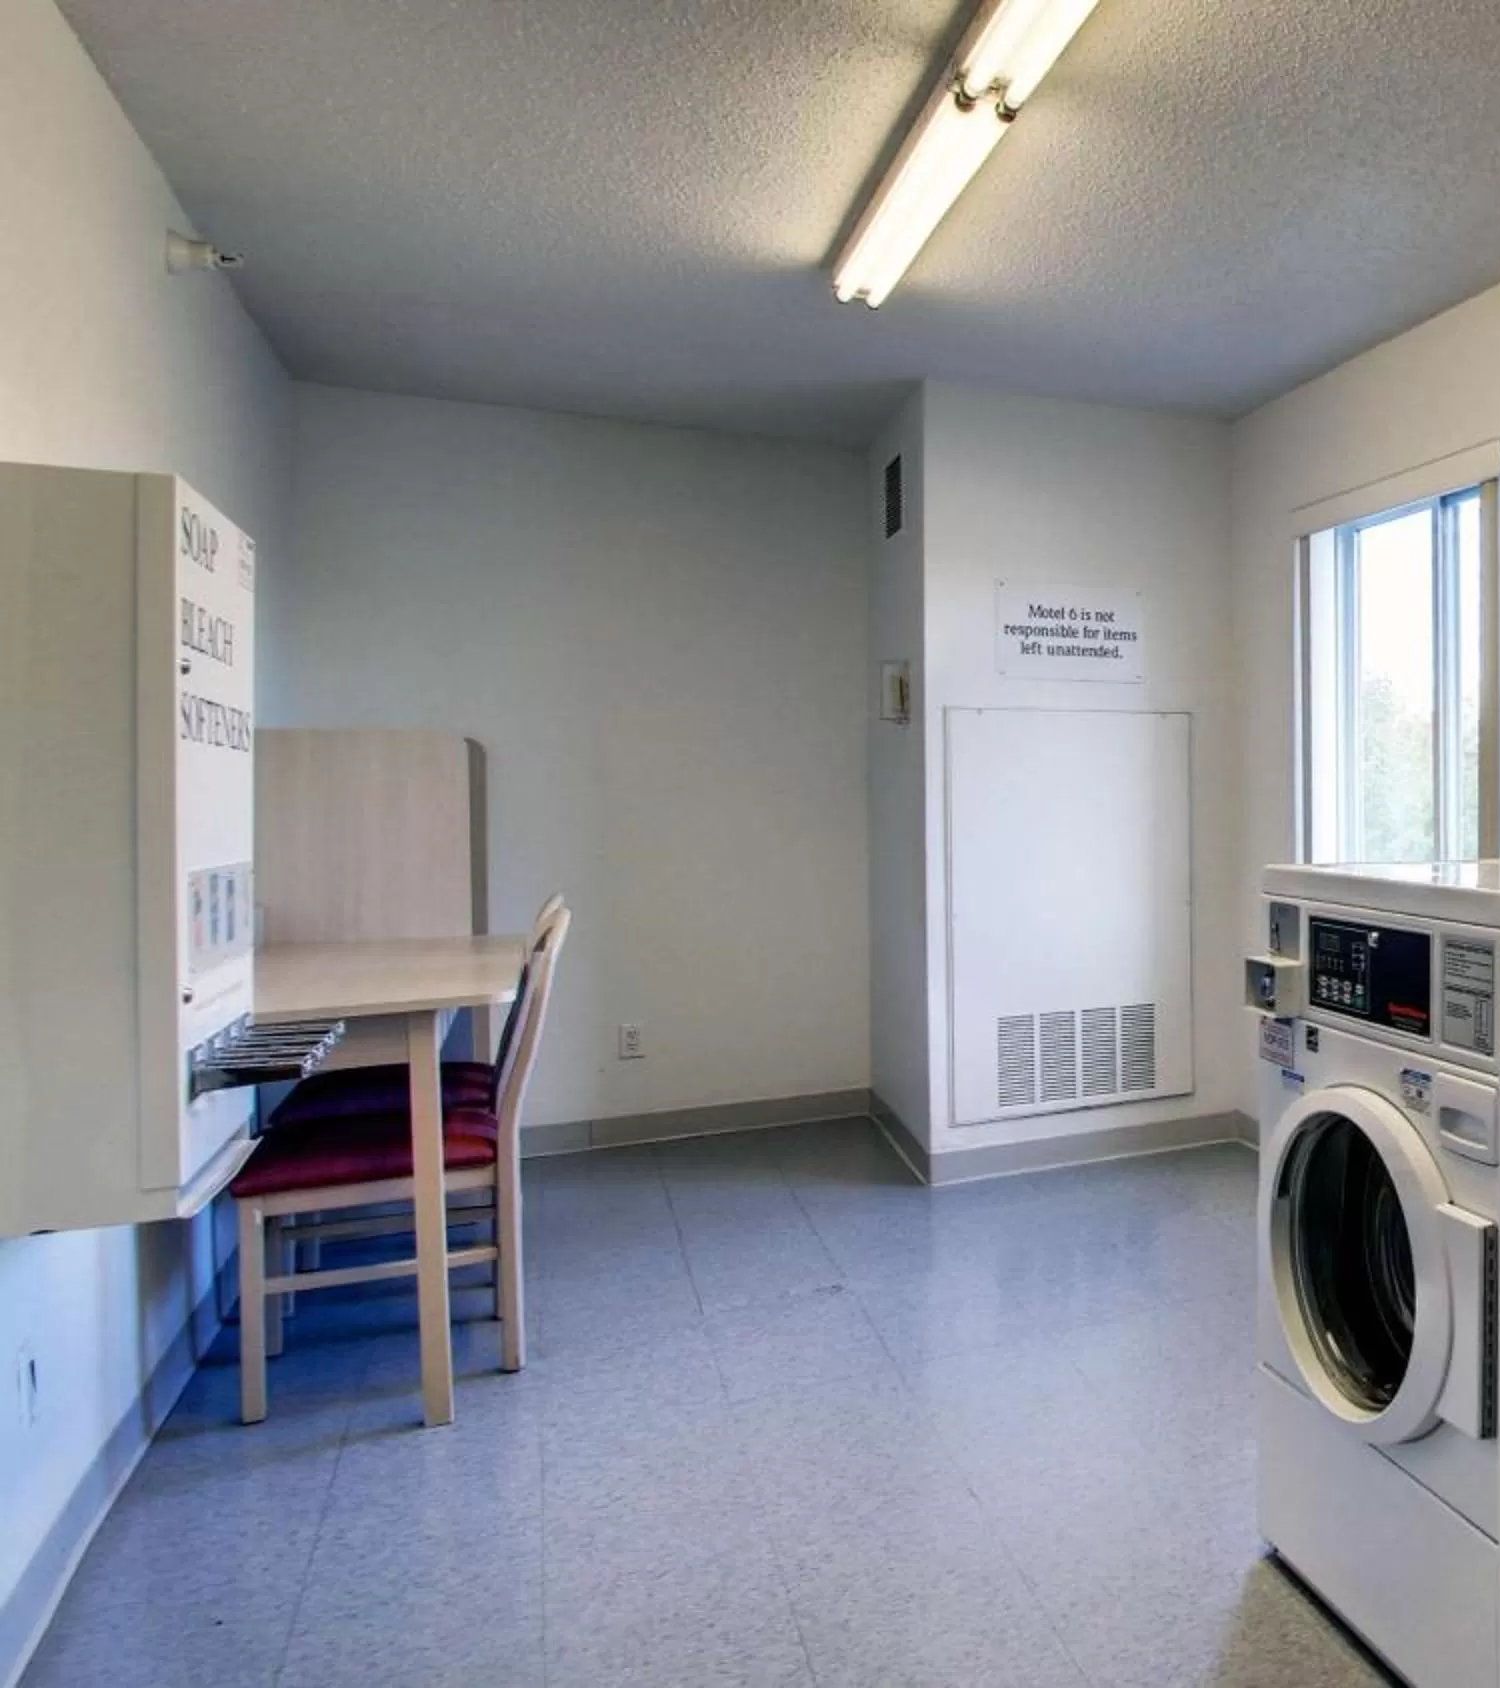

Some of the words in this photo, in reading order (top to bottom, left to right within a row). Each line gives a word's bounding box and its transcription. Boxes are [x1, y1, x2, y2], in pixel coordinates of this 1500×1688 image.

[181, 506, 219, 574] SOAP
[181, 597, 234, 667] BLEACH
[1003, 623, 1080, 640] responsible
[1083, 625, 1101, 640] for
[1103, 627, 1138, 642] items
[1028, 604, 1065, 620] Motel
[1068, 608, 1078, 621] 6
[1080, 608, 1092, 621] is
[1095, 610, 1116, 622] not
[1019, 640, 1043, 656] left
[1047, 644, 1124, 659] unattended.
[181, 691, 251, 752] SOFTENERS
